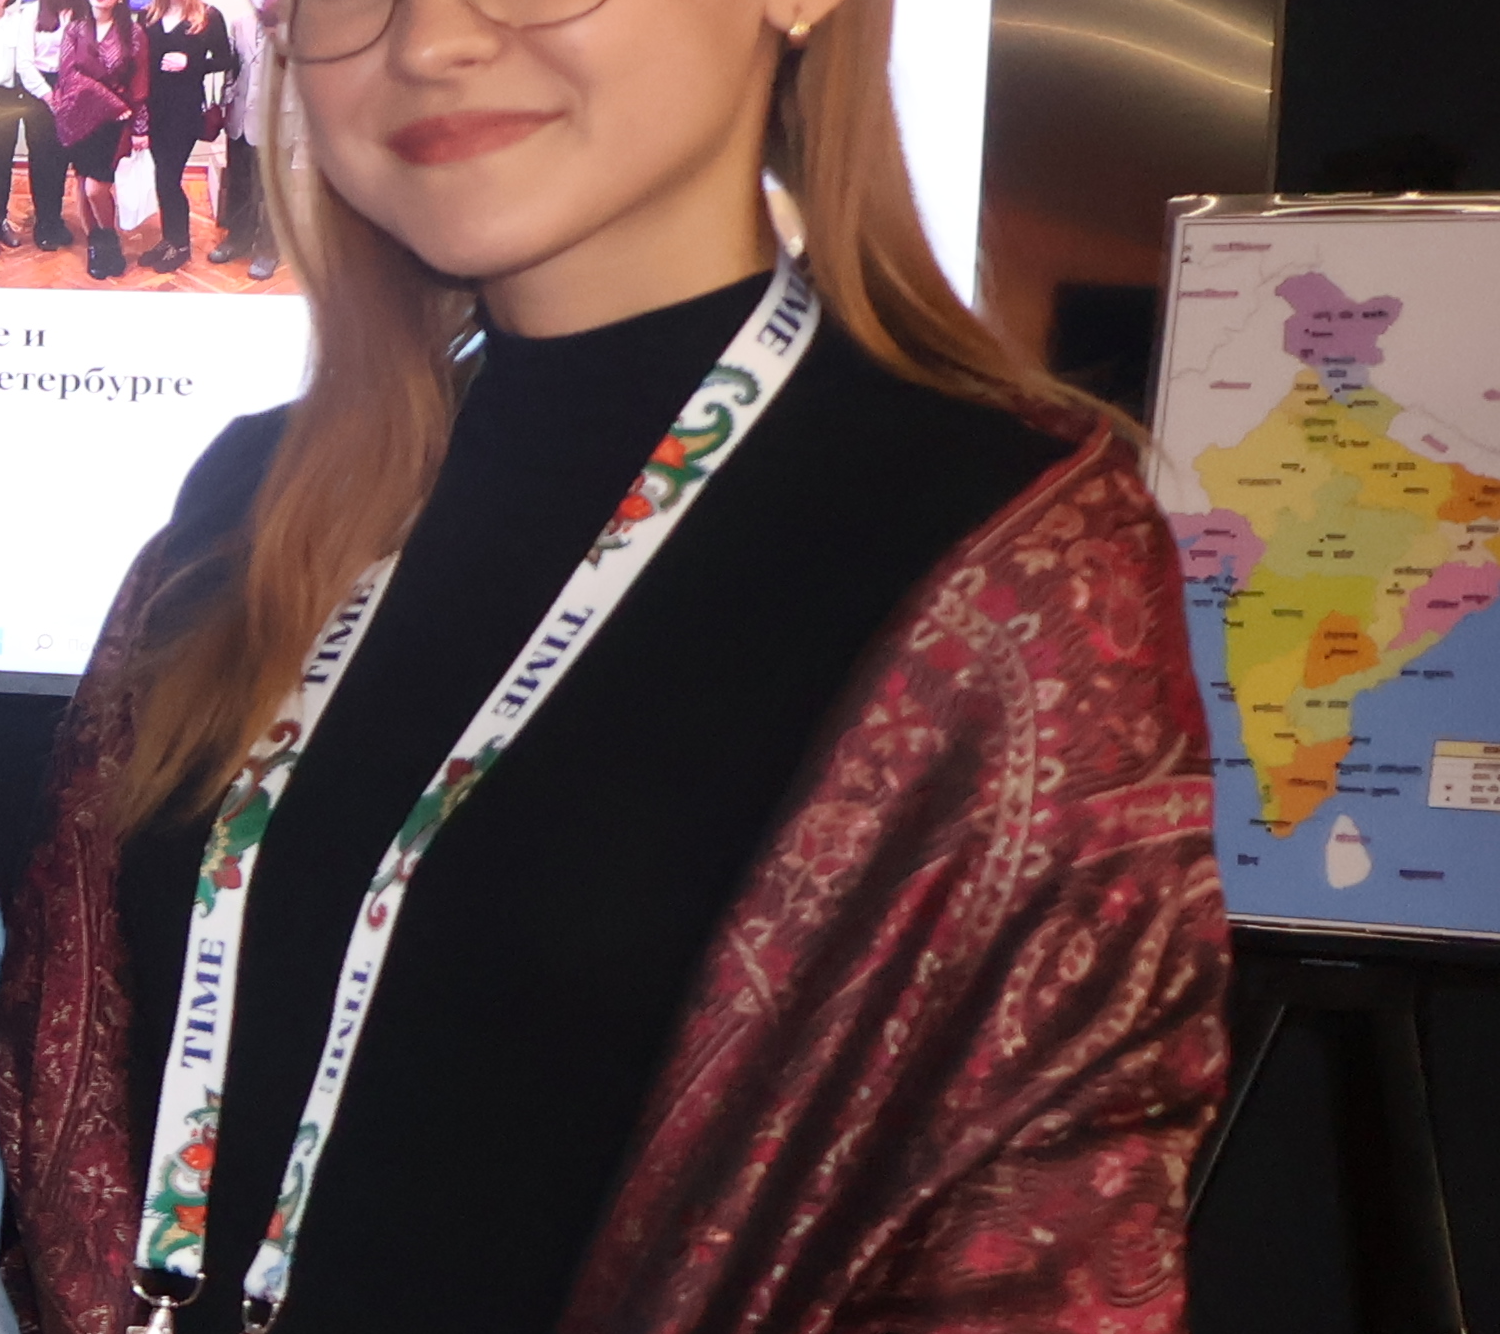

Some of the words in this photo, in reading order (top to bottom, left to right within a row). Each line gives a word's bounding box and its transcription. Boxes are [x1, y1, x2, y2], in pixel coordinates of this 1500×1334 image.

[23, 328, 46, 347] и
[493, 606, 594, 720] TIME
[182, 937, 226, 1068] TIME
